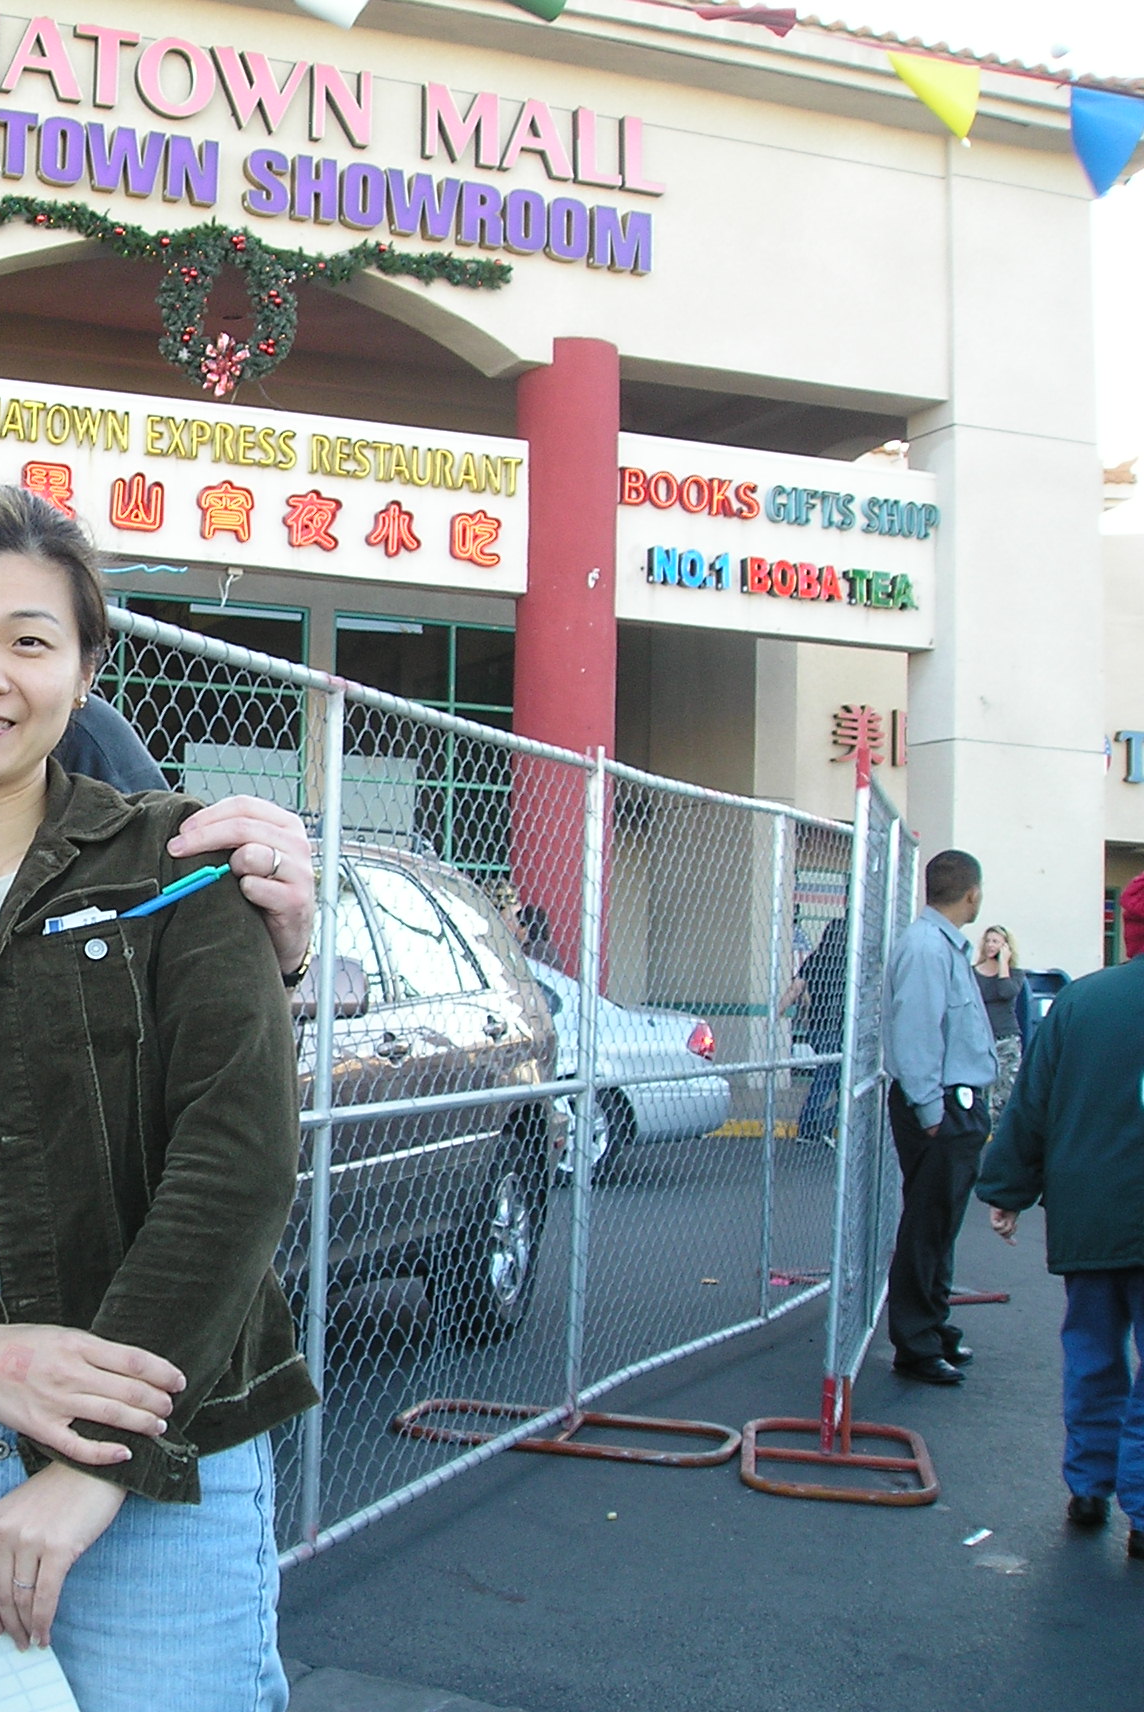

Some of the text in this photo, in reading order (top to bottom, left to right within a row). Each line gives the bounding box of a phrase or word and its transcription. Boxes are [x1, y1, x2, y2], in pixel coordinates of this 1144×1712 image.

[421, 80, 665, 194] MALL
[242, 148, 652, 275] SHOWROOM
[145, 415, 297, 470] EXPRESS
[309, 434, 524, 498] RESTAURANT
[619, 466, 941, 540] BOOKS GIFTS SHOP
[647, 546, 919, 611] NO.1 BOBA TEA
[831, 704, 907, 767] 美
